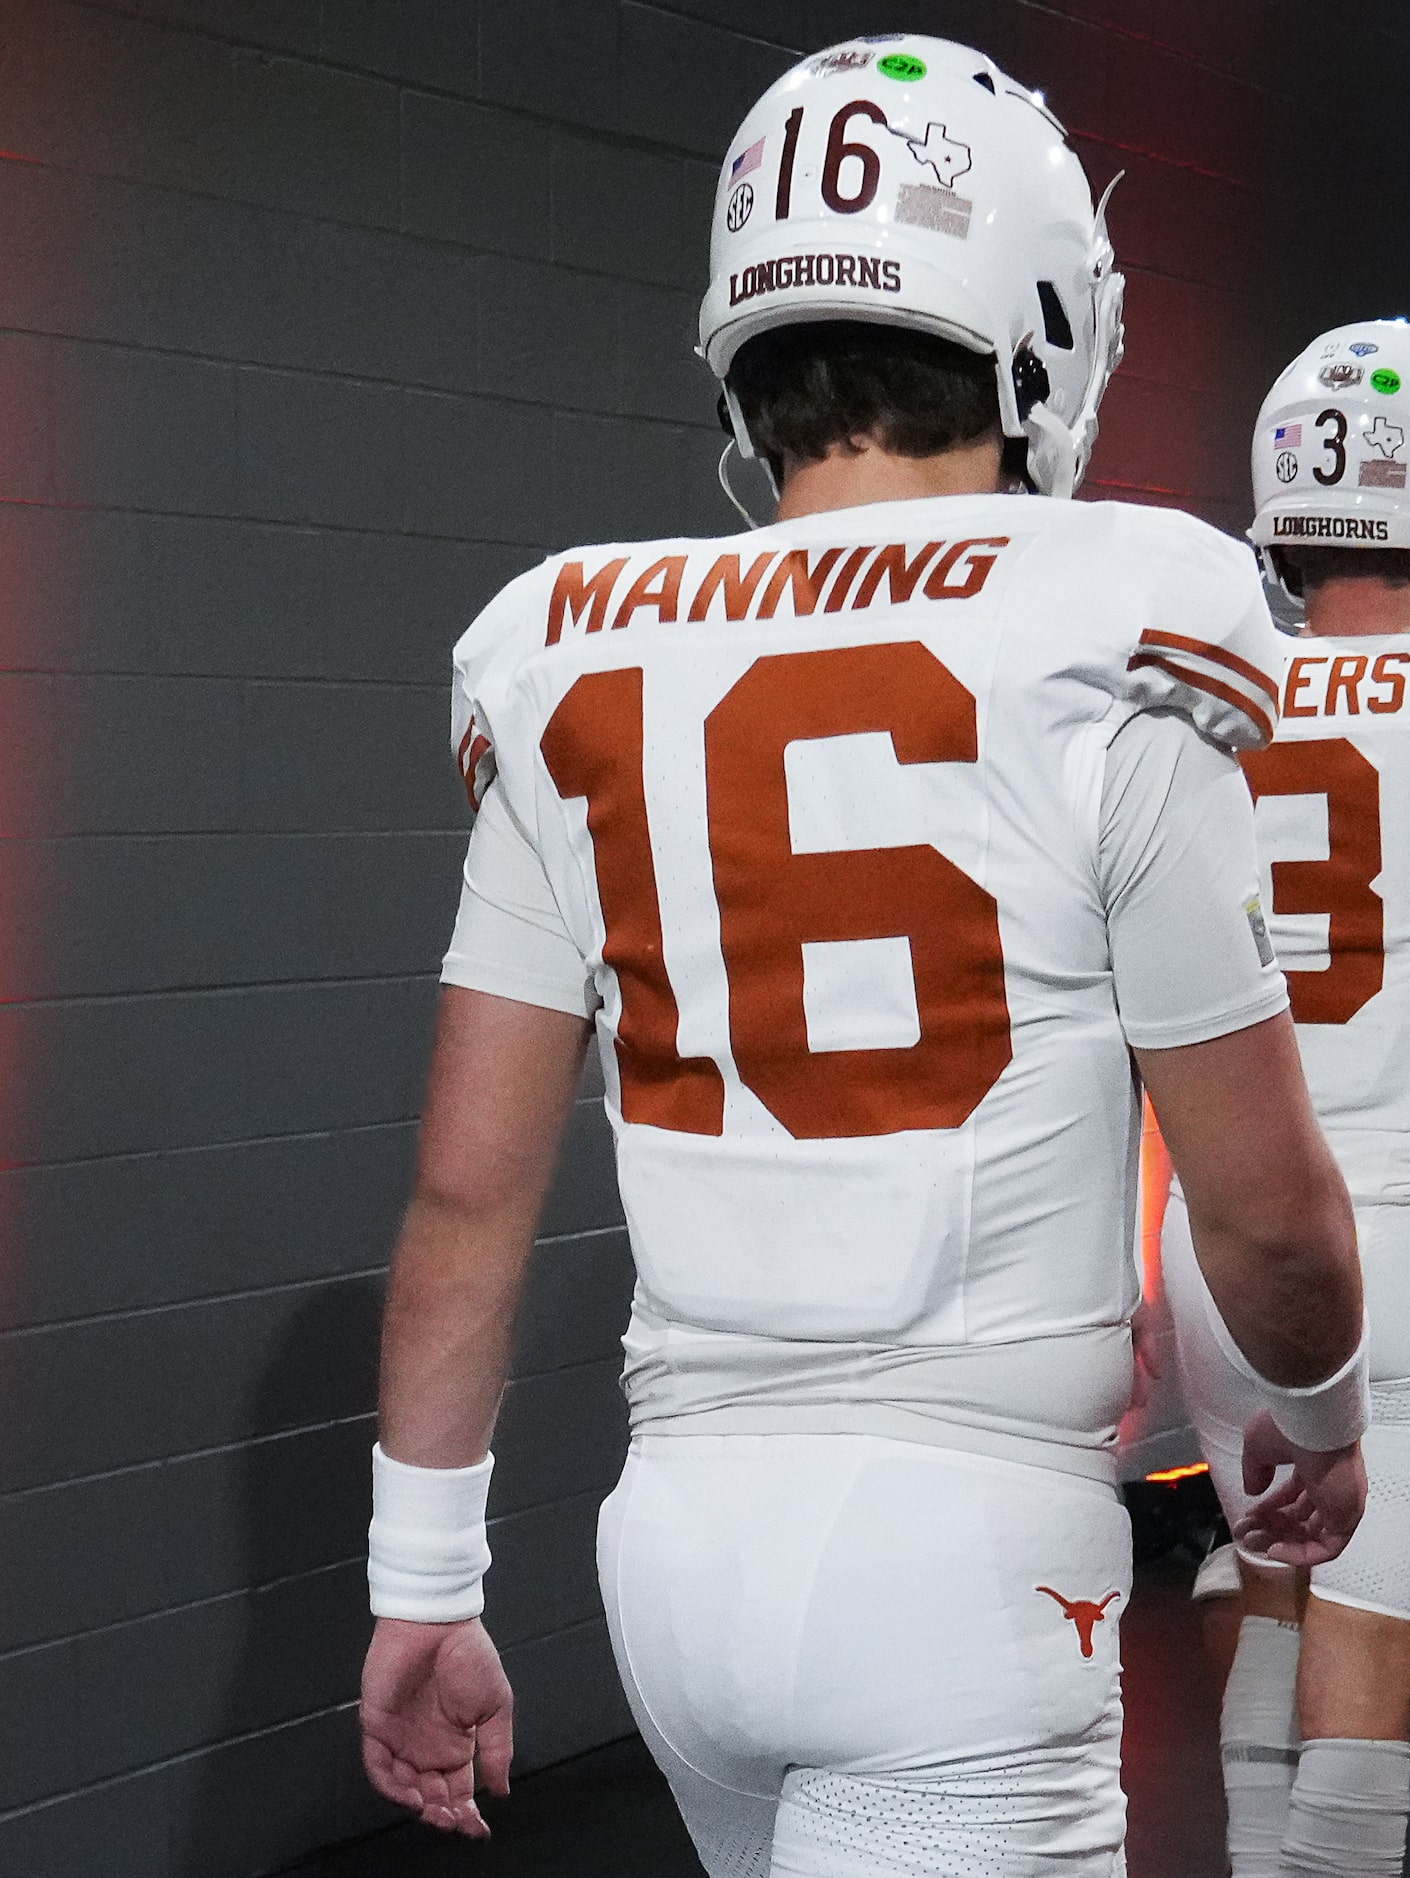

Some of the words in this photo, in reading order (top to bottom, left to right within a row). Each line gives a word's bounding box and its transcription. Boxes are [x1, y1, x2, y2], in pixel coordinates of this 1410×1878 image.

[775, 100, 888, 220] 16
[727, 185, 754, 231] SEC
[729, 254, 901, 307] LONGHORNS
[1312, 408, 1348, 486] 3
[1273, 517, 1388, 540] LONGHORNS
[545, 536, 1010, 647] MANNING
[540, 640, 1013, 1140] 16
[1237, 738, 1384, 1025] 3
